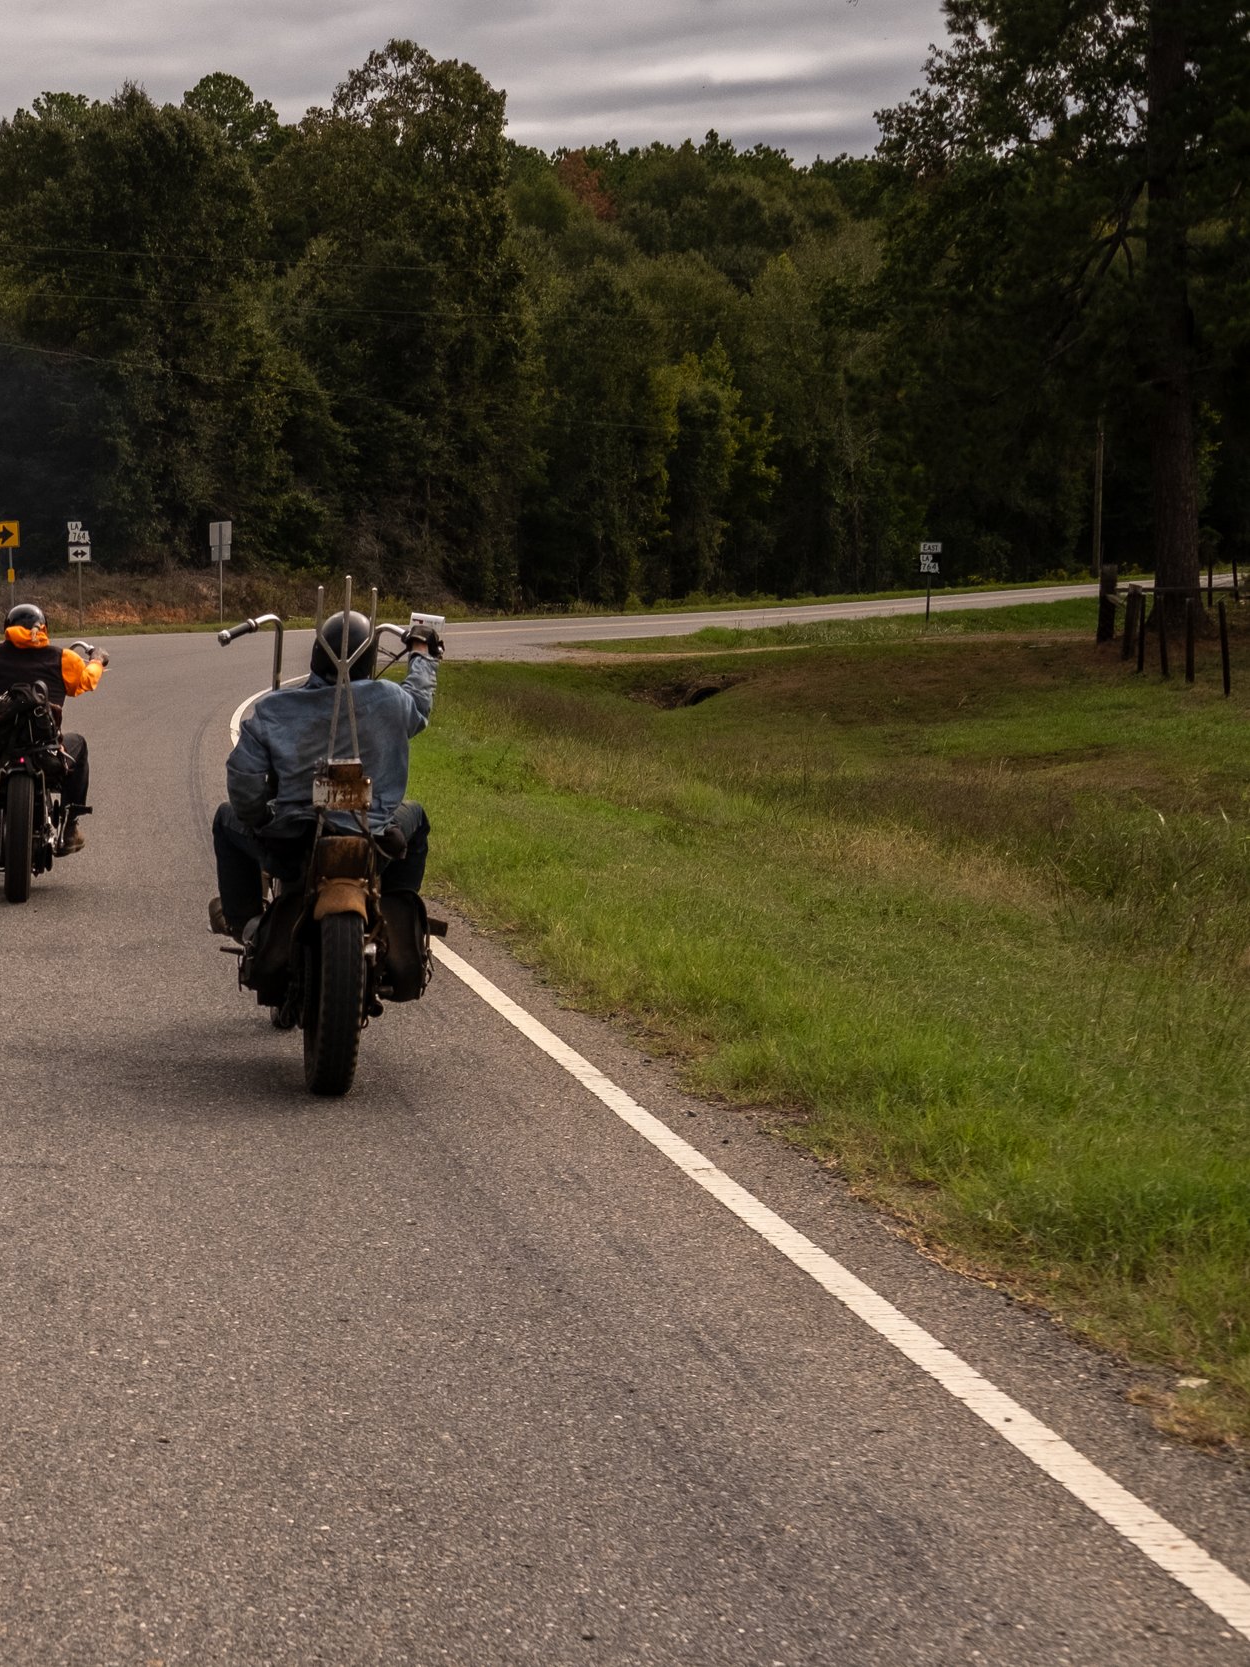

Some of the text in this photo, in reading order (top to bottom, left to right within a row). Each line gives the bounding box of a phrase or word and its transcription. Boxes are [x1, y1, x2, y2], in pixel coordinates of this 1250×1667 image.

[70, 523, 80, 531] LA
[72, 532, 86, 541] 764
[923, 543, 938, 551] EAST
[921, 563, 937, 571] 764
